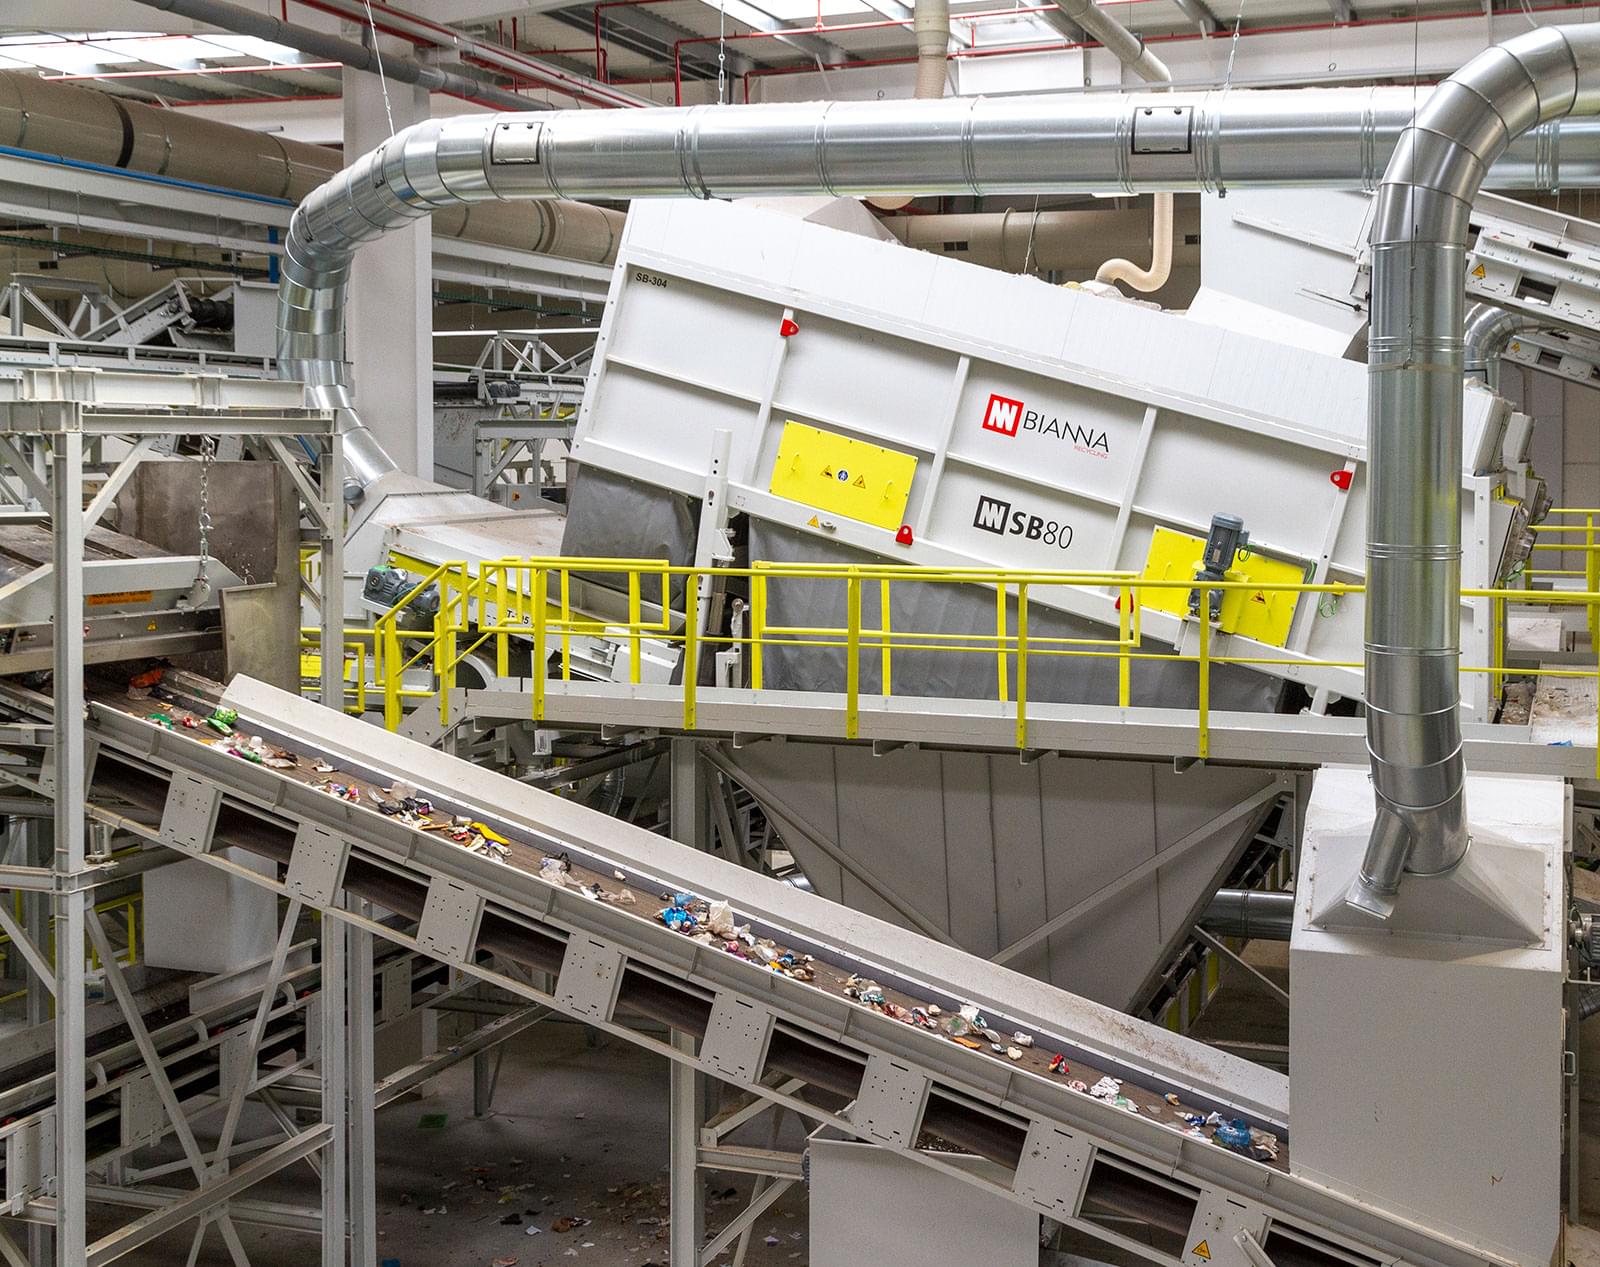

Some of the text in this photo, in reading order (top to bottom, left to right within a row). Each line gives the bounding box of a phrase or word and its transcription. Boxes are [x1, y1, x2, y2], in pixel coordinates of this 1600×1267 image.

[635, 272, 668, 288] SB-304
[1023, 410, 1109, 453] BIANNA
[1009, 511, 1073, 550] SB80
